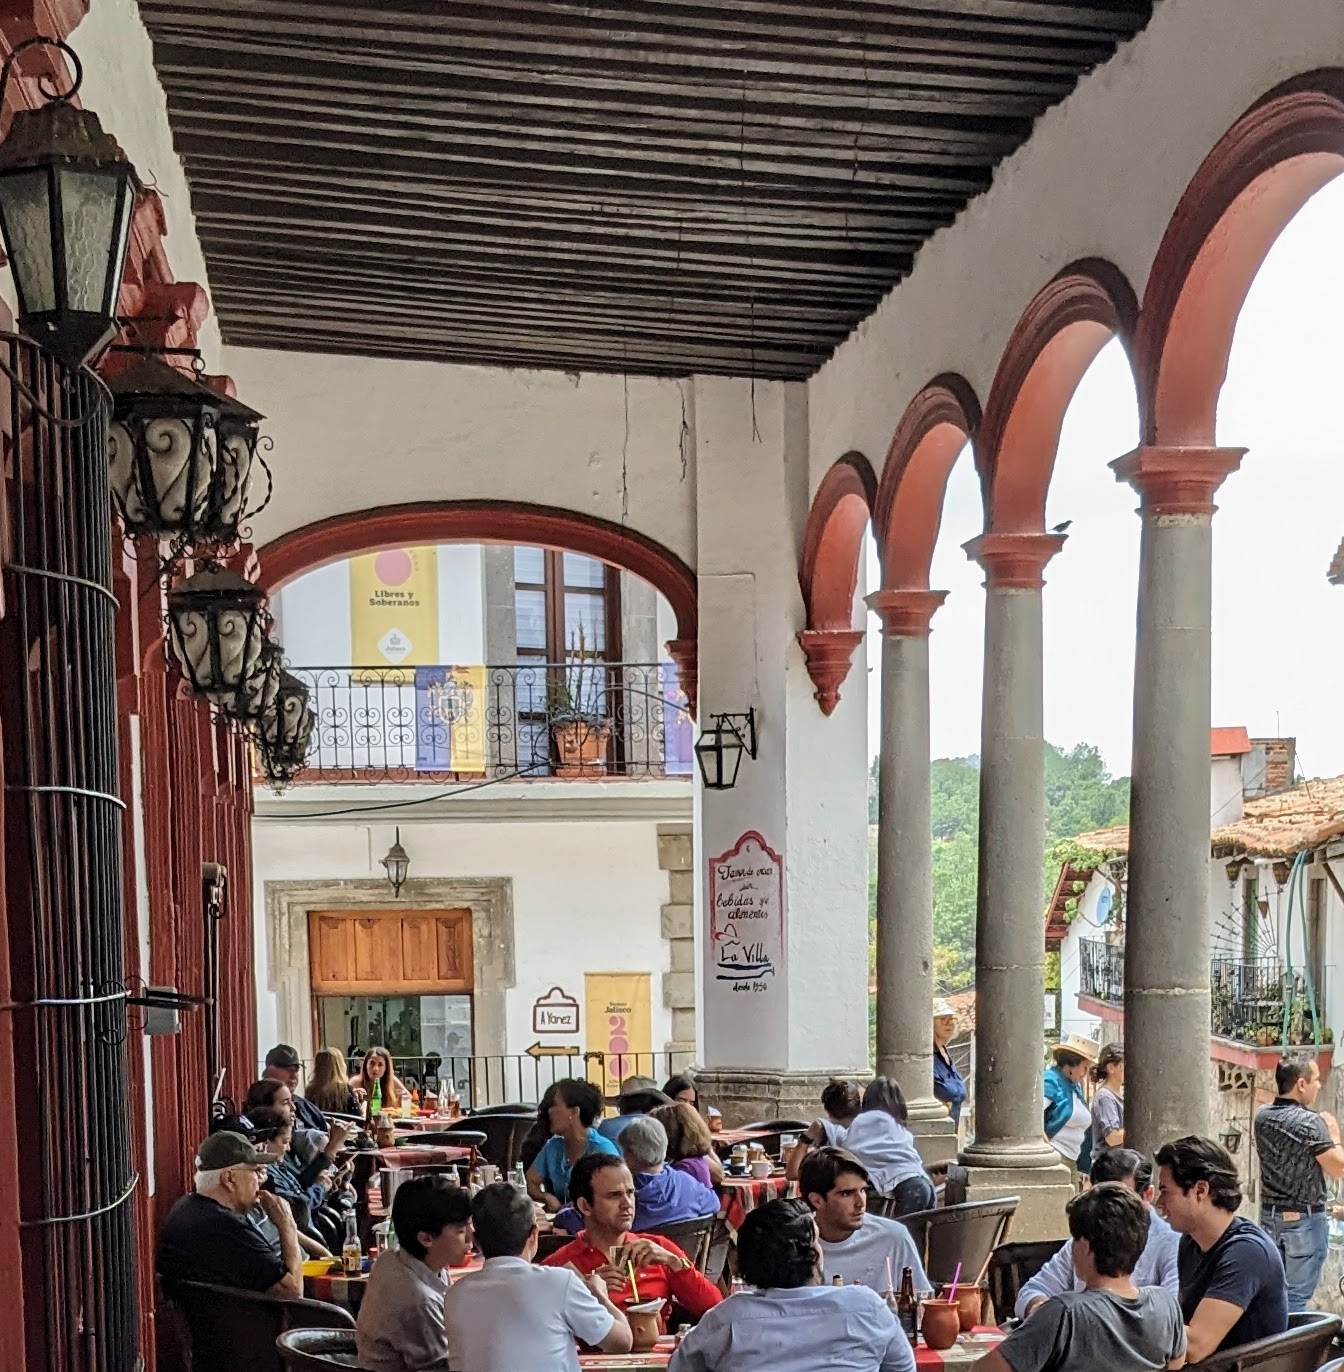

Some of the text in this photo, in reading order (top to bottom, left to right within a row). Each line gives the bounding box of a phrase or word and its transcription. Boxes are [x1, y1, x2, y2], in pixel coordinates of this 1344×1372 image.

[374, 590, 405, 598] Libres
[369, 598, 420, 607] Soberanos
[716, 892, 754, 907] bebidas
[727, 907, 769, 920] alimentos
[721, 942, 770, 963] La Villa
[733, 981, 751, 992] desde
[604, 1006, 632, 1014] Jalisco
[540, 1011, 571, 1025] A Yanez
